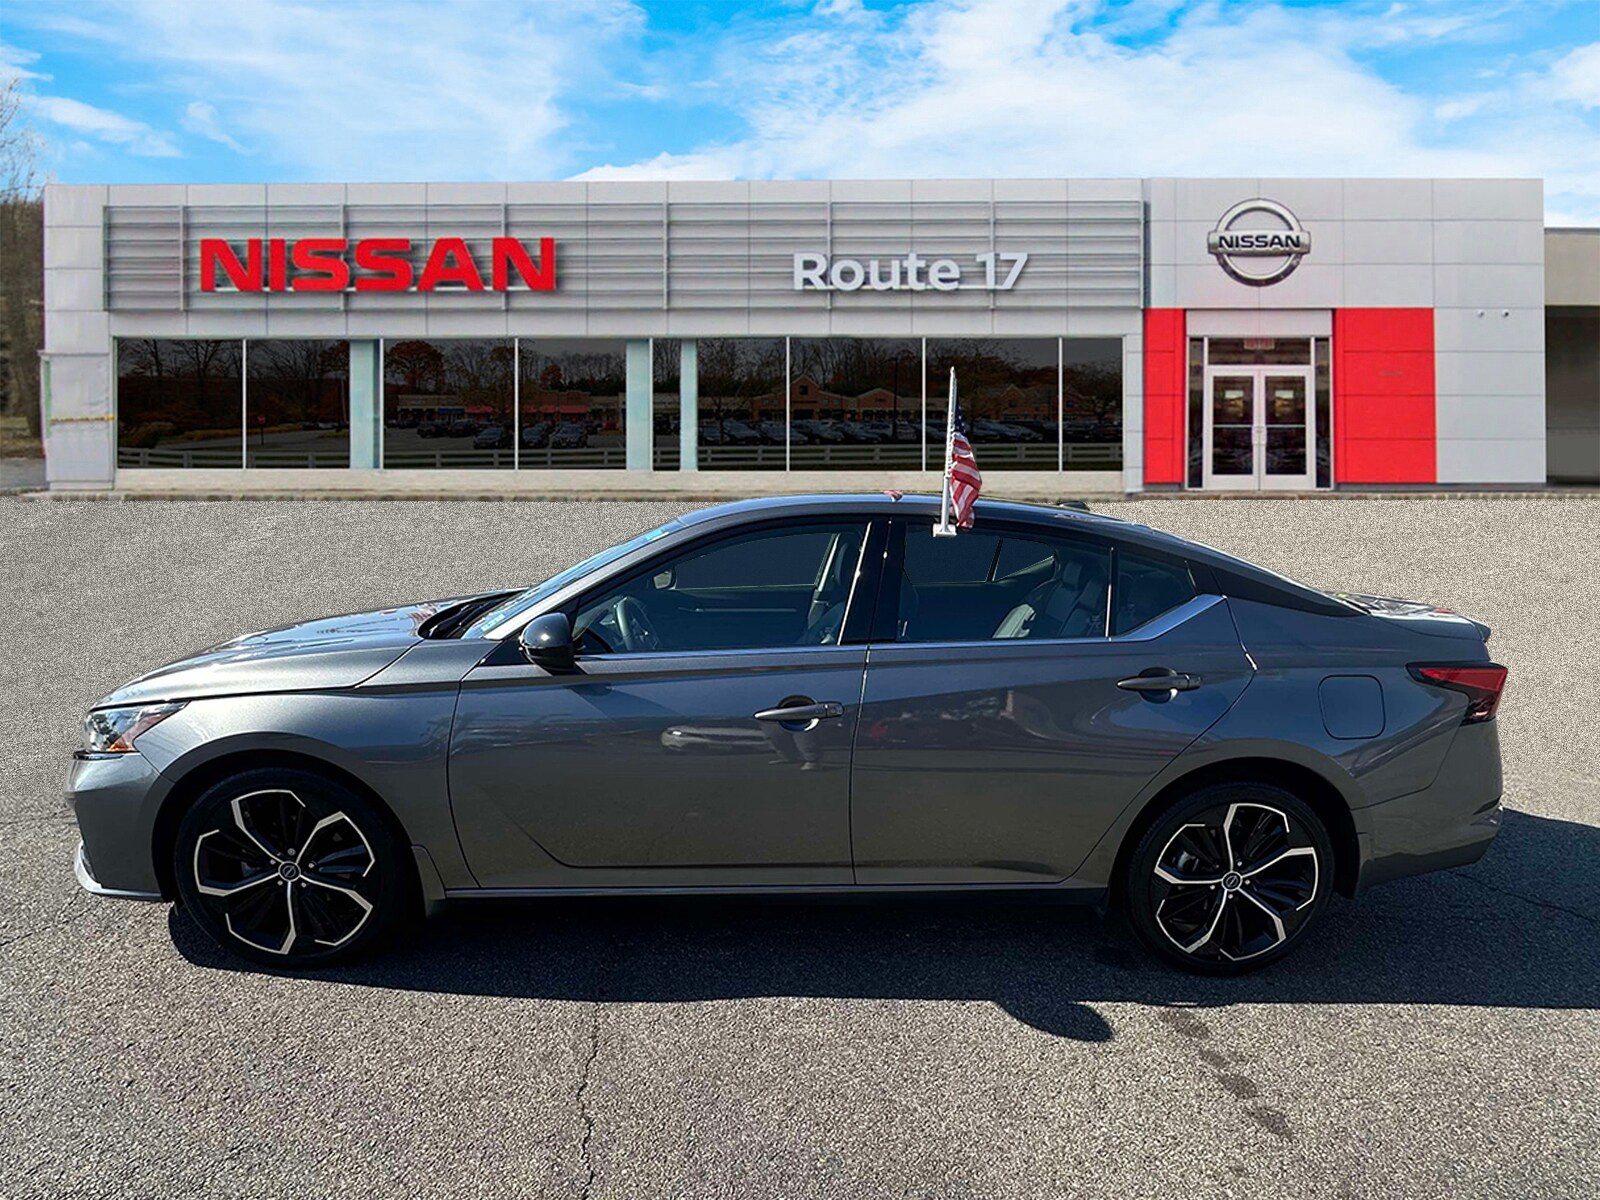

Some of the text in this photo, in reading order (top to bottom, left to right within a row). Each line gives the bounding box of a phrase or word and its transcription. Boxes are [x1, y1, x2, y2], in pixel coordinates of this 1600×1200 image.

[1218, 235, 1300, 248] NISSAN
[200, 237, 556, 292] NISSAN
[793, 252, 1028, 291] Route 17
